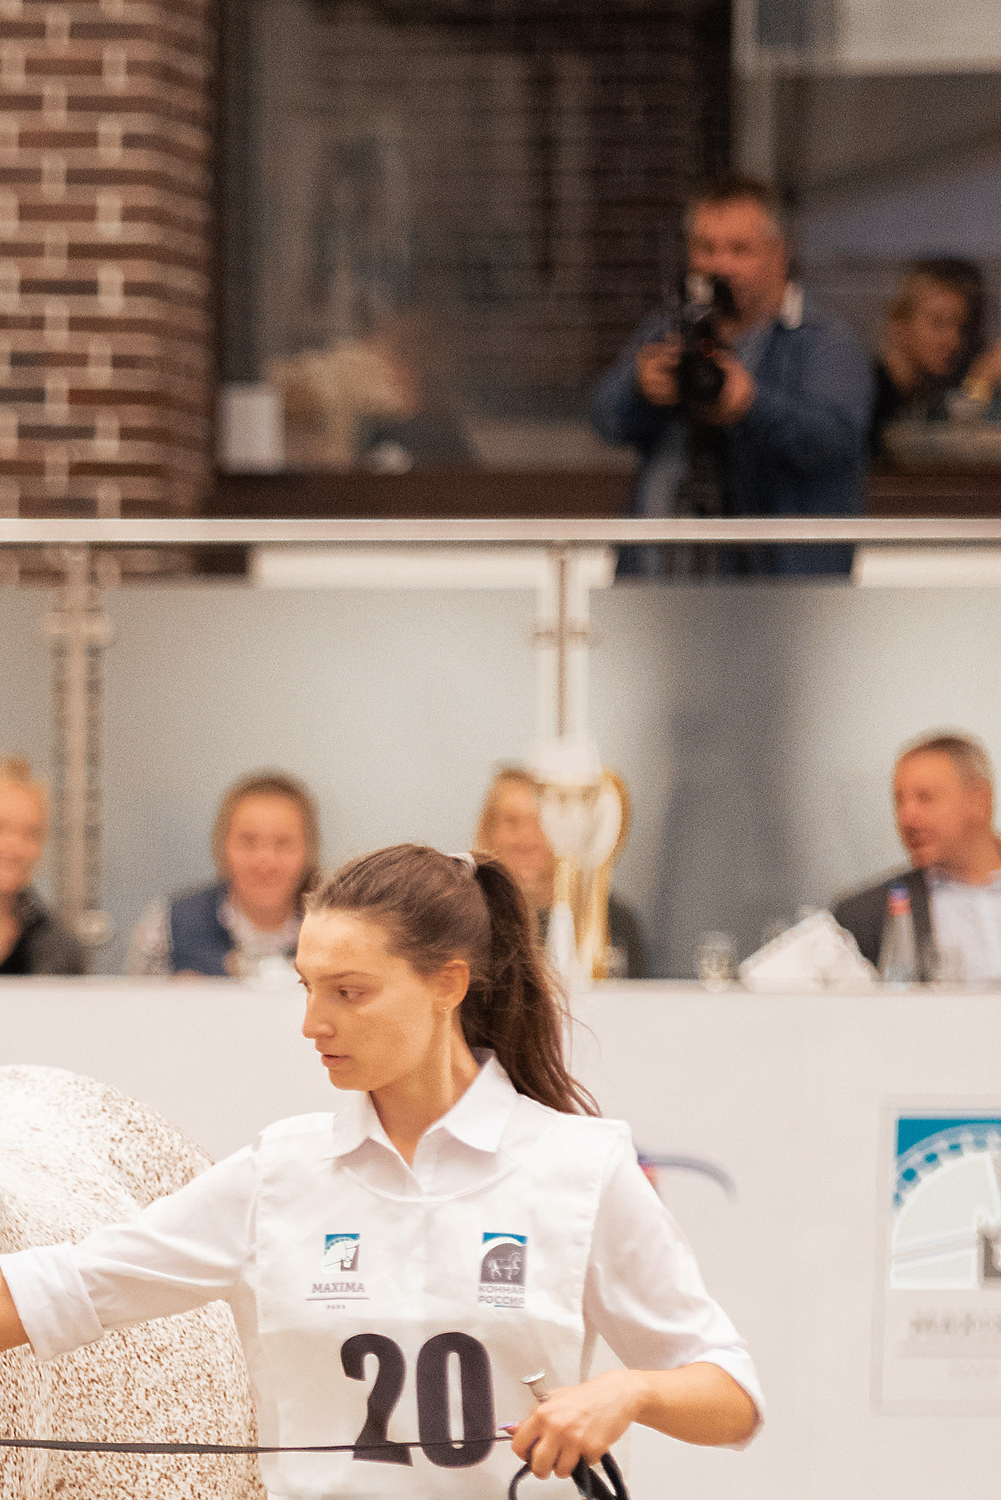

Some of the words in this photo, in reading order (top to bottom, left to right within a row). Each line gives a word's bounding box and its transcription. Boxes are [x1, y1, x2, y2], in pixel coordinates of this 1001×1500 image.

[311, 1282, 366, 1294] MAXIMA
[478, 1285, 525, 1295] КОННАЯ
[478, 1295, 525, 1306] РОССИЯ
[340, 1331, 496, 1468] 20
